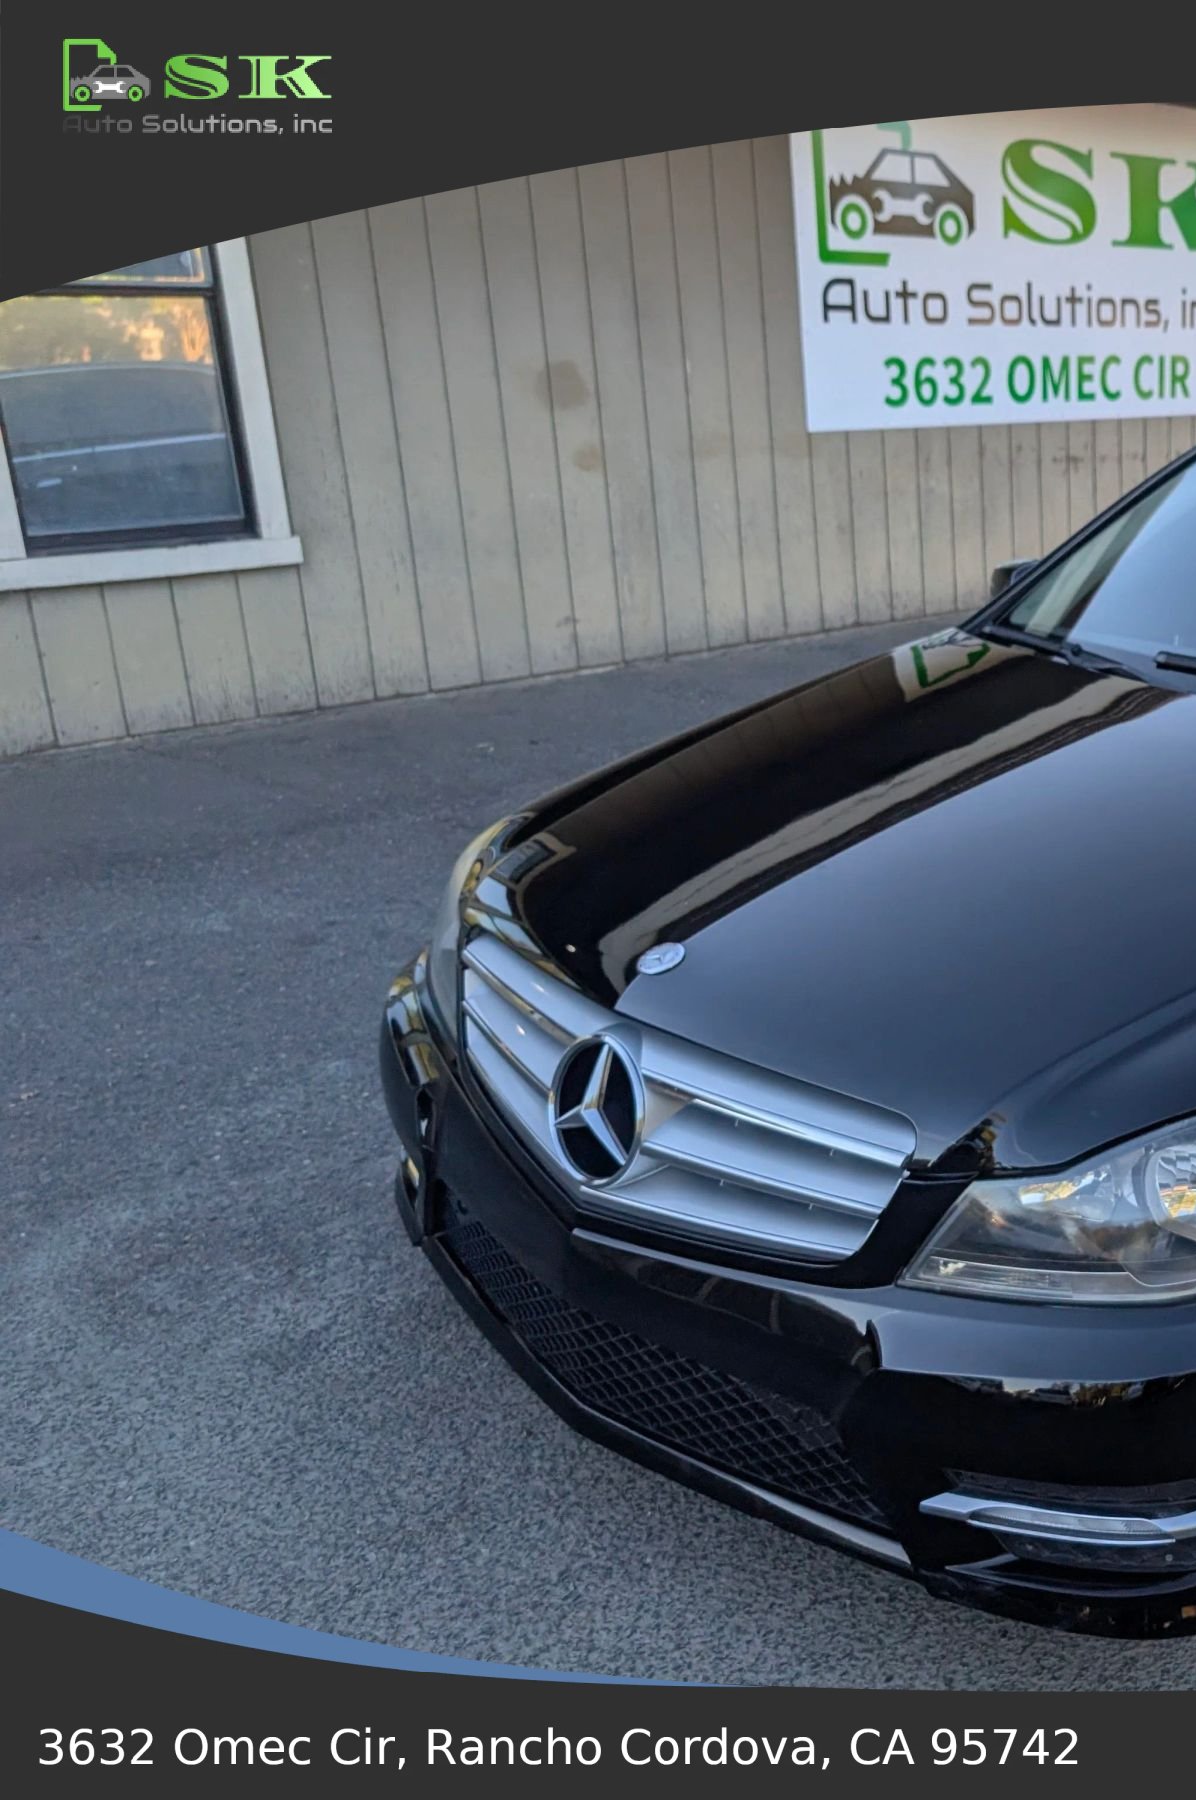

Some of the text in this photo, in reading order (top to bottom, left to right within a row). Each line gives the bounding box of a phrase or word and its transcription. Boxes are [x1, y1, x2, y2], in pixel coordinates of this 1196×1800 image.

[822, 278, 948, 326] Auto
[966, 282, 1170, 332] Solutions,
[884, 354, 1191, 408] 3632 OMEC CIR
